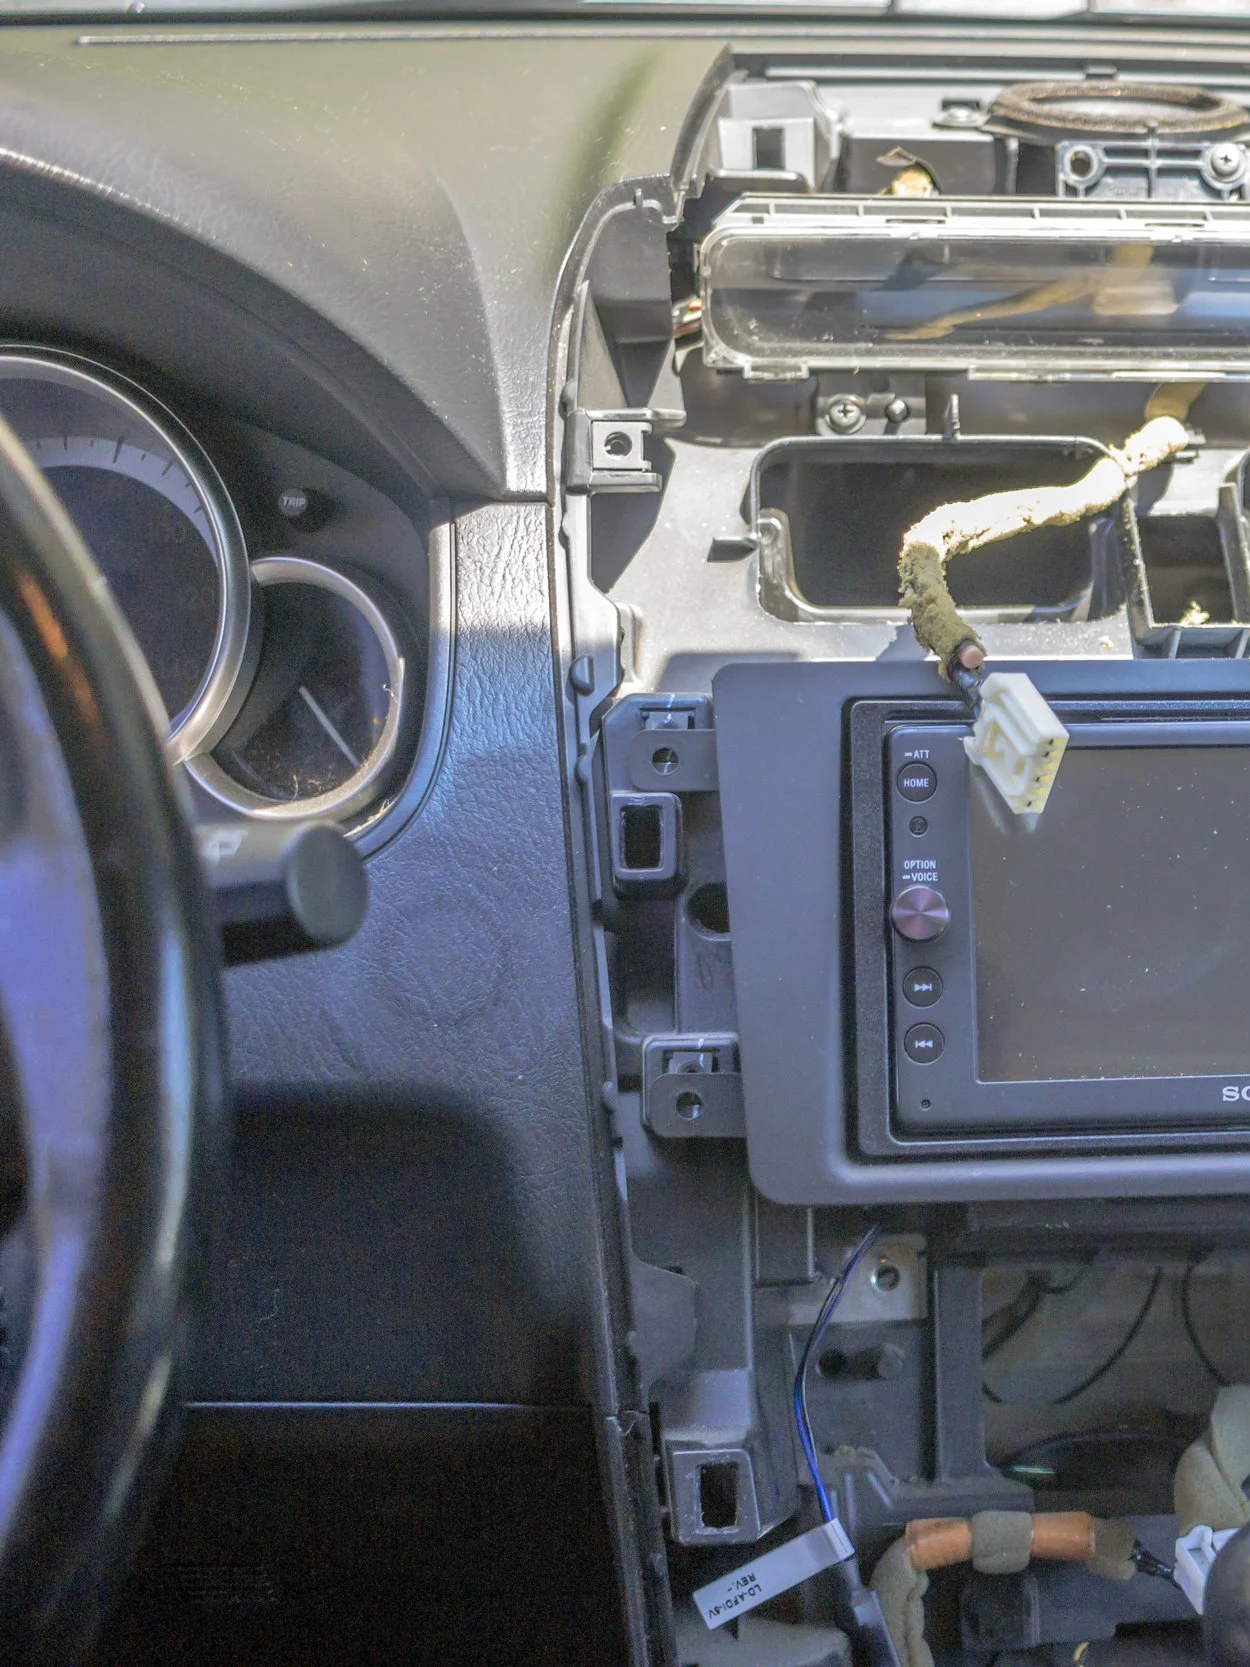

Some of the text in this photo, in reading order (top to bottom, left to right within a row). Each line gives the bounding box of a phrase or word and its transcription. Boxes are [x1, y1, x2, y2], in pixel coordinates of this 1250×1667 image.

[282, 496, 306, 508] TRIP
[903, 778, 929, 788] HOME
[904, 860, 936, 870] OPTION
